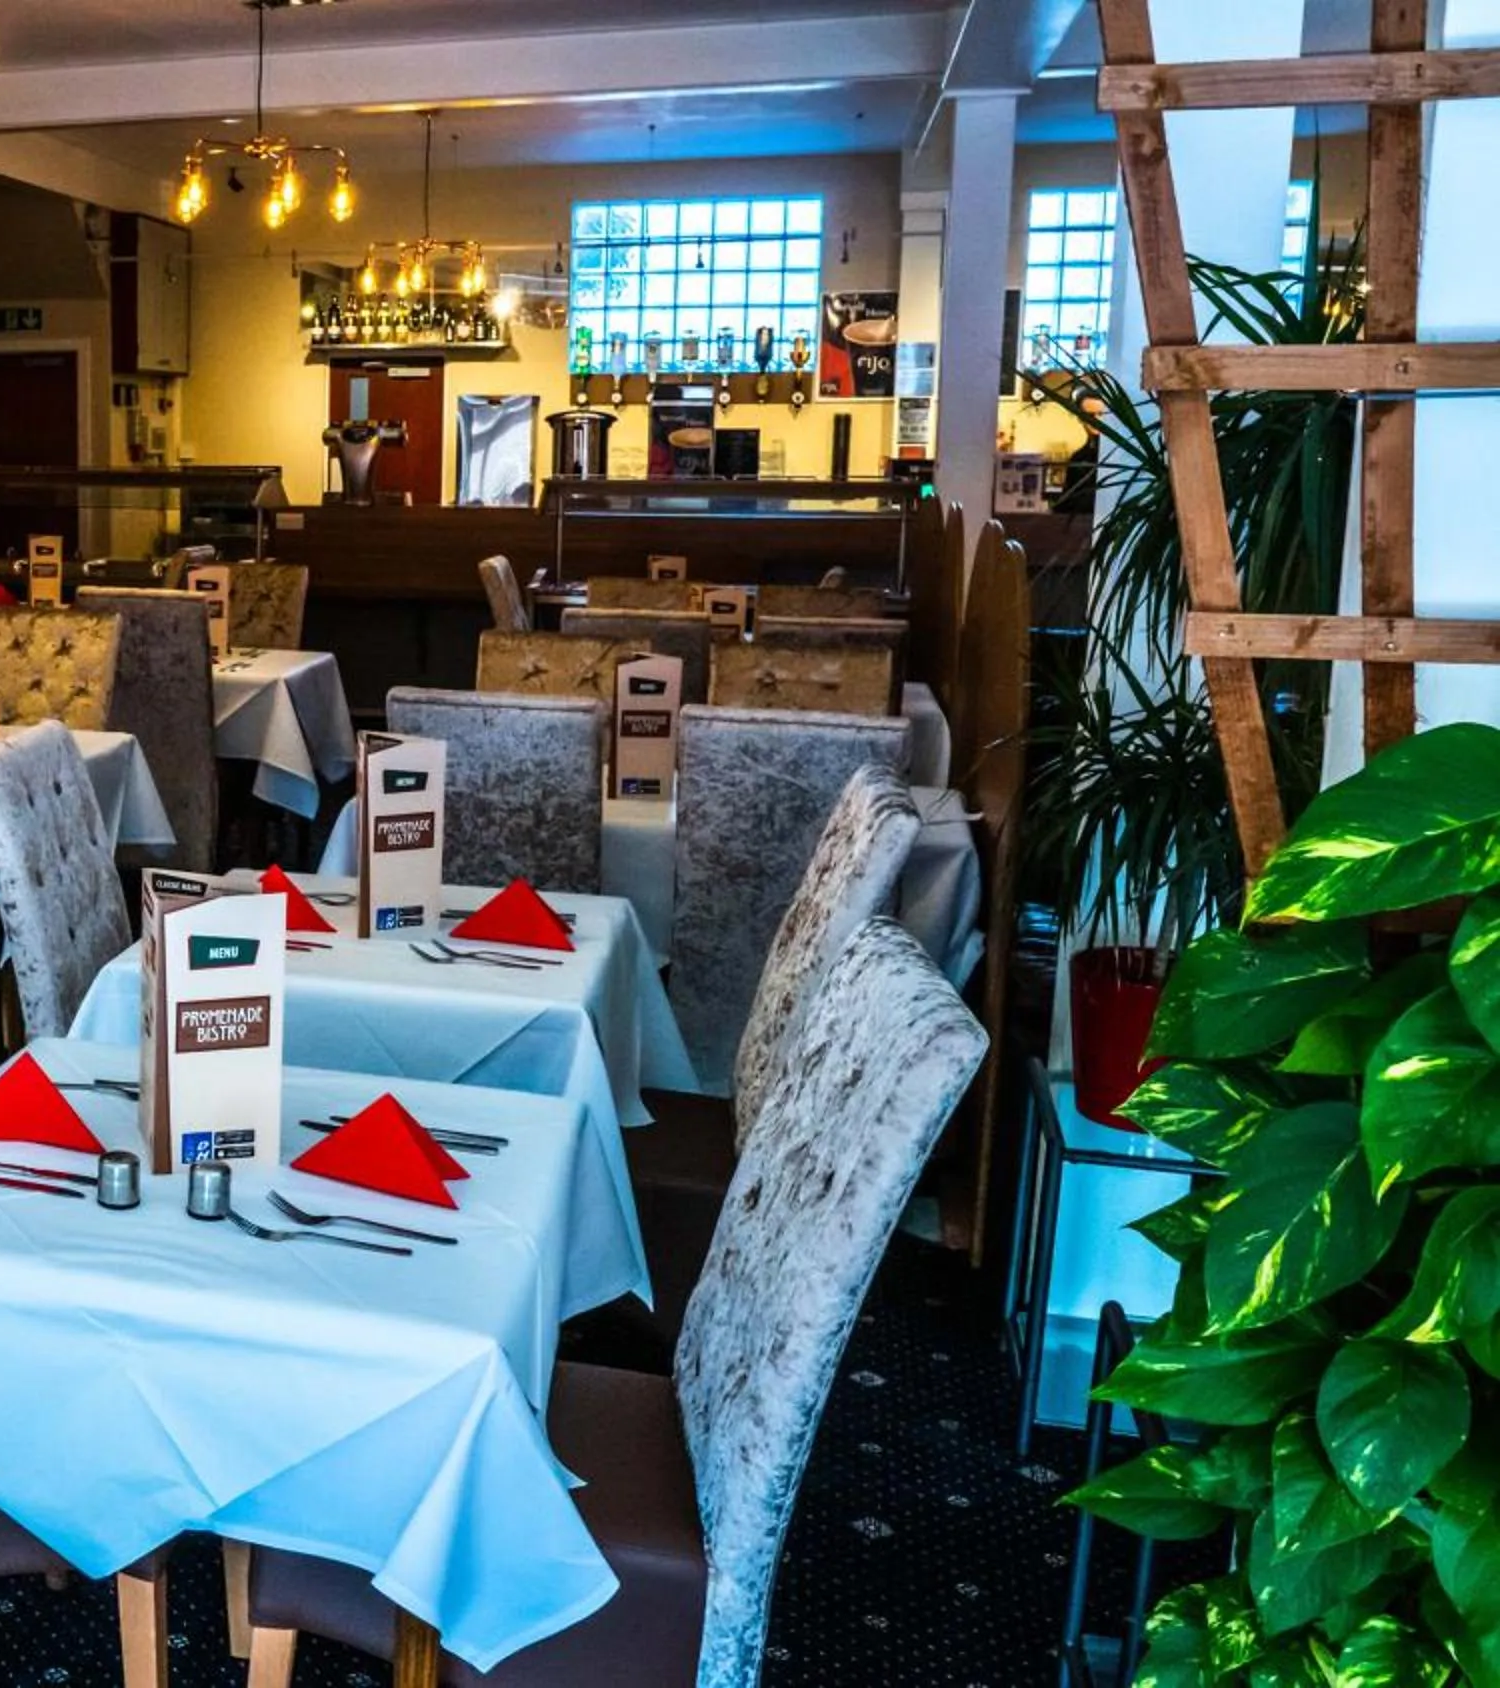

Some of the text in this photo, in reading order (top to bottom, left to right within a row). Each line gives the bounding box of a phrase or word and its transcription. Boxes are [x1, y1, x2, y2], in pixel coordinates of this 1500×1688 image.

[209, 946, 239, 960] MENU
[181, 1005, 263, 1029] PROMENADE
[196, 1023, 248, 1043] BISTRO
